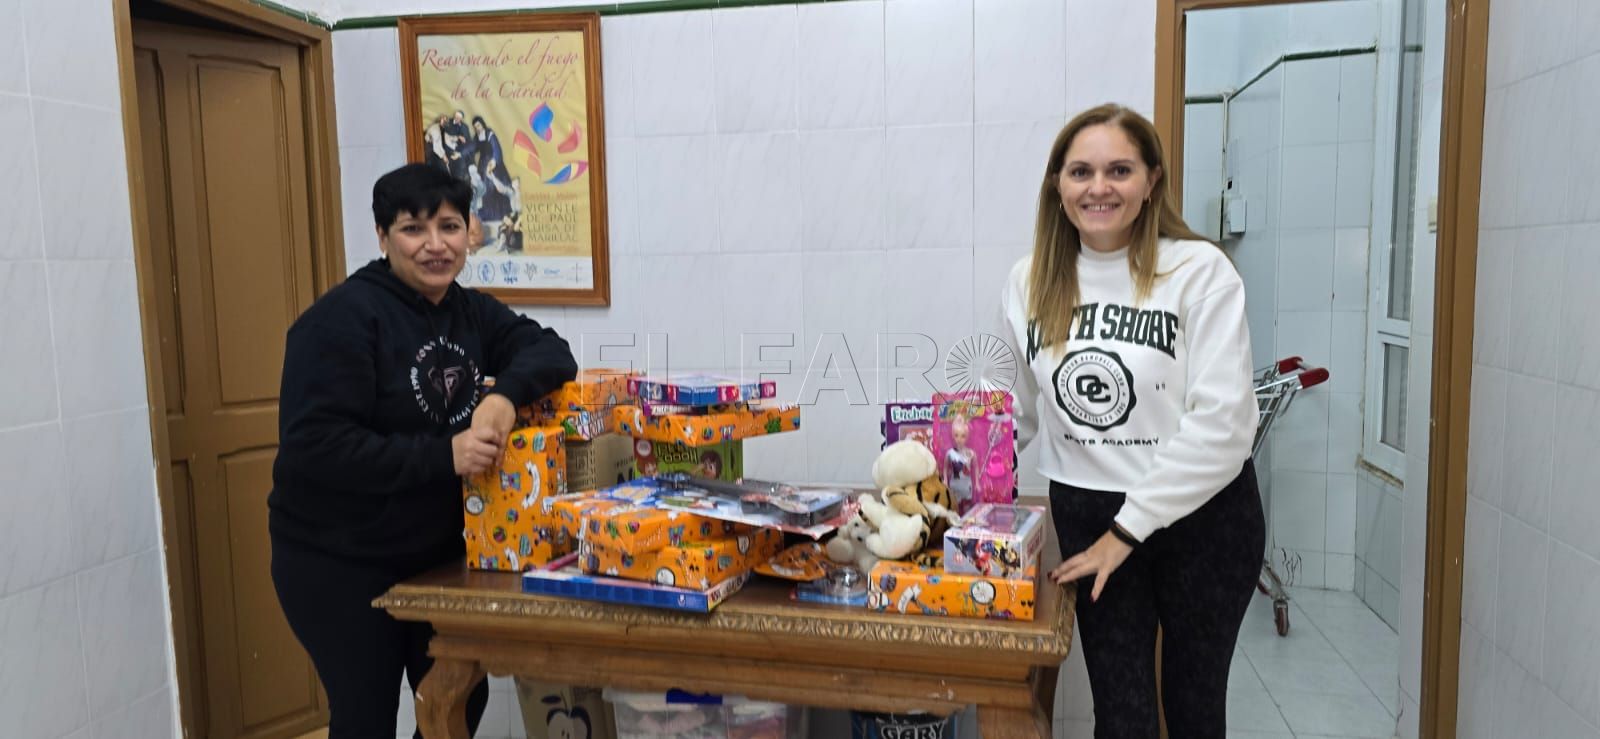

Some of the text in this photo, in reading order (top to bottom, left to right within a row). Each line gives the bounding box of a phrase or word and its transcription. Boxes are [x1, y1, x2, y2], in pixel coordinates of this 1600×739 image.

[421, 36, 578, 83] Reavivando el fuego
[451, 72, 575, 99] de la Caridad
[526, 203, 576, 214] VICENTE
[1026, 302, 1179, 367] NTH SHORE
[1076, 375, 1111, 403] OC
[1101, 435, 1160, 447] ACADEMY
